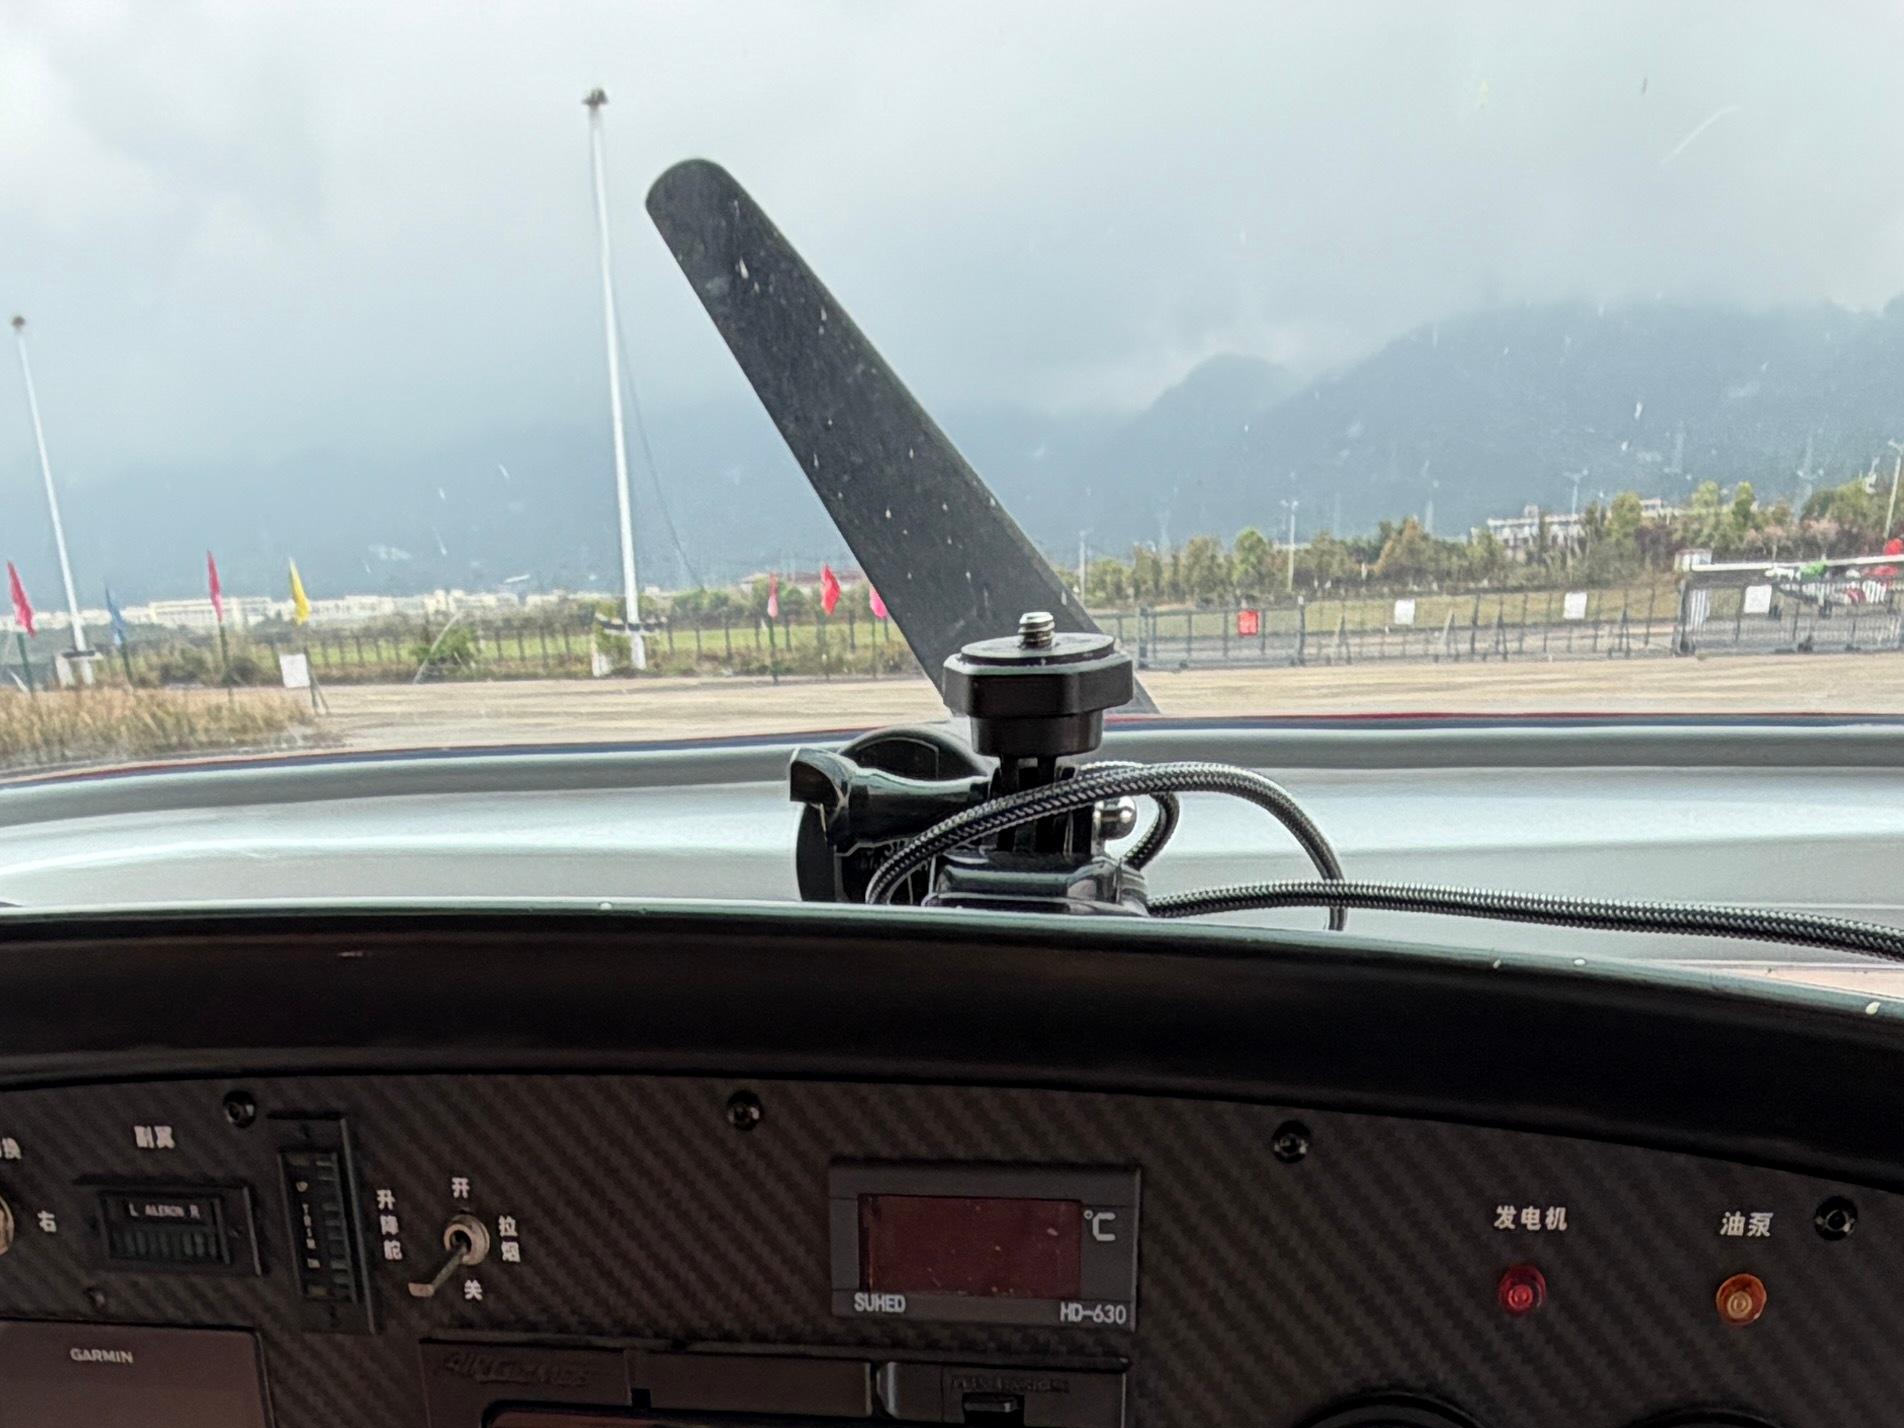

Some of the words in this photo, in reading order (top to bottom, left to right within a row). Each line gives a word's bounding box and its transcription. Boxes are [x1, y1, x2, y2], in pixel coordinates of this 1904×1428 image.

[452, 1177, 470, 1198] 开
[37, 1210, 57, 1233] 右
[1493, 1205, 1569, 1231] 发电机
[1720, 1211, 1774, 1237] 油泵
[464, 1279, 483, 1301] 关
[1060, 1301, 1127, 1325] HD-630
[69, 1347, 135, 1364] GARMIN
